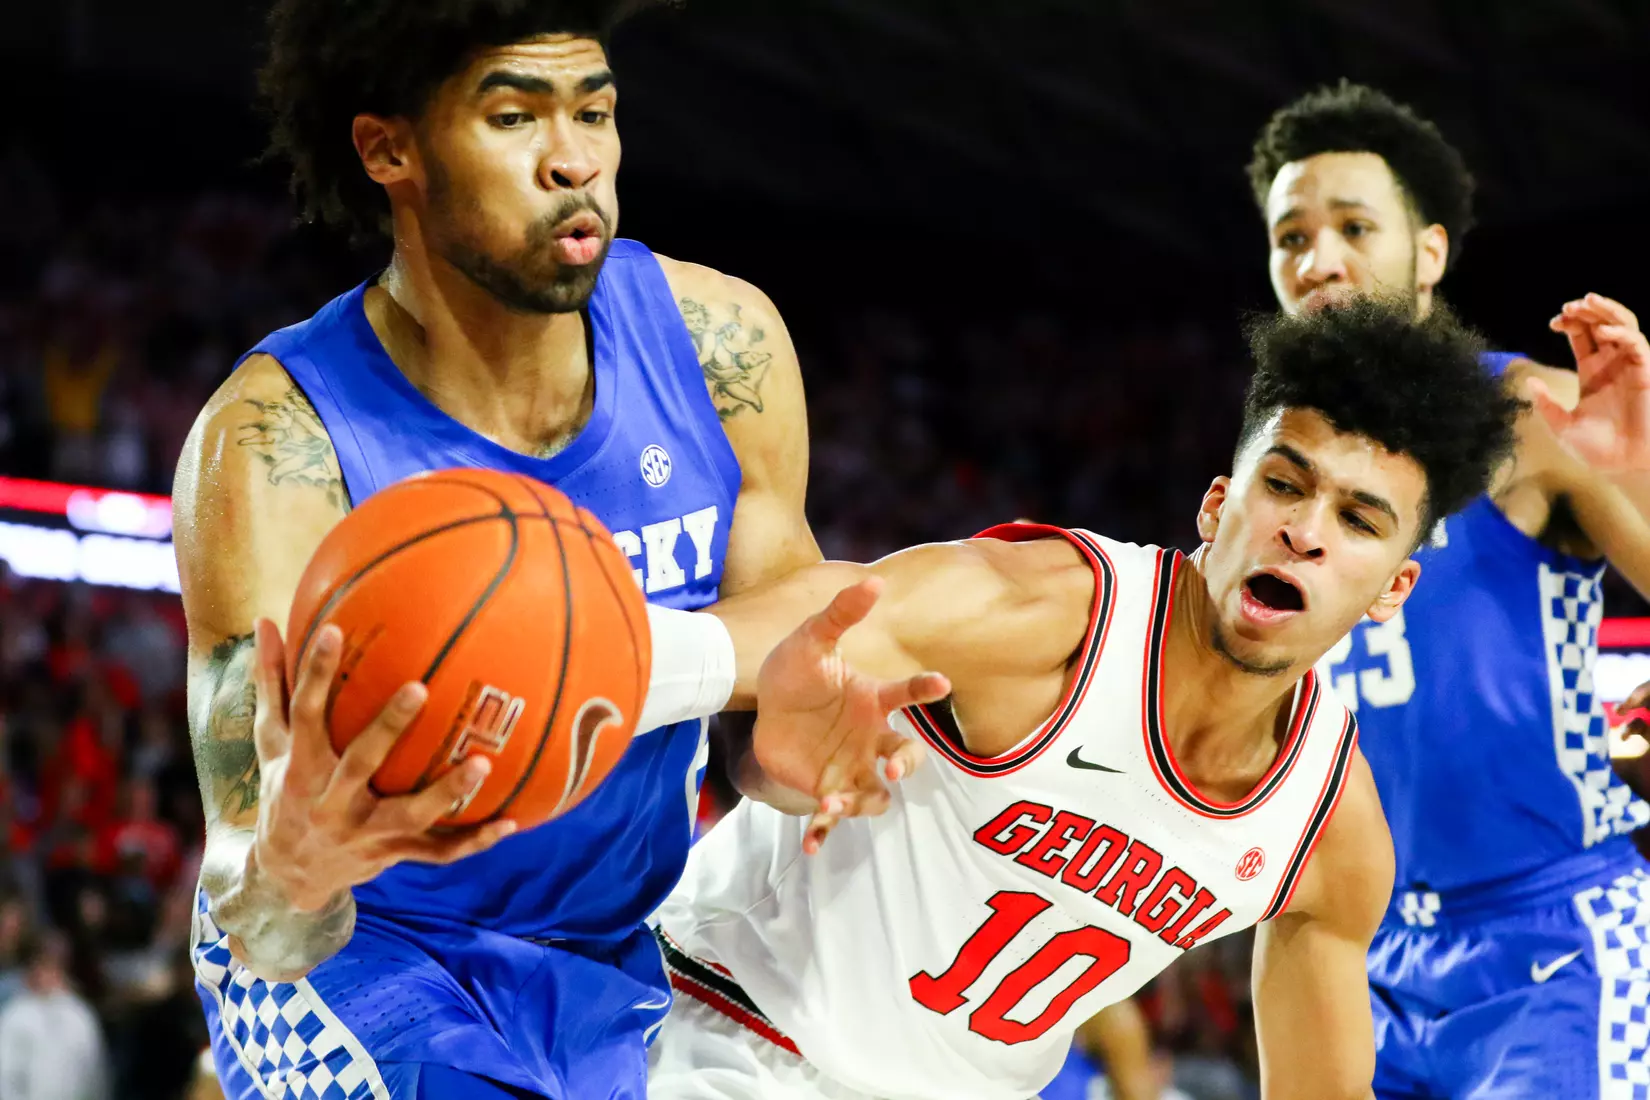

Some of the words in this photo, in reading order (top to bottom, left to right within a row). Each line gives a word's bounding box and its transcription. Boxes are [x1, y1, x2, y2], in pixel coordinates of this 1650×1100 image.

[642, 447, 671, 487] SEC
[1316, 606, 1416, 713] 23
[972, 800, 1233, 951] GEORGIA
[1237, 849, 1264, 879] SEC
[908, 890, 1131, 1045] 10
